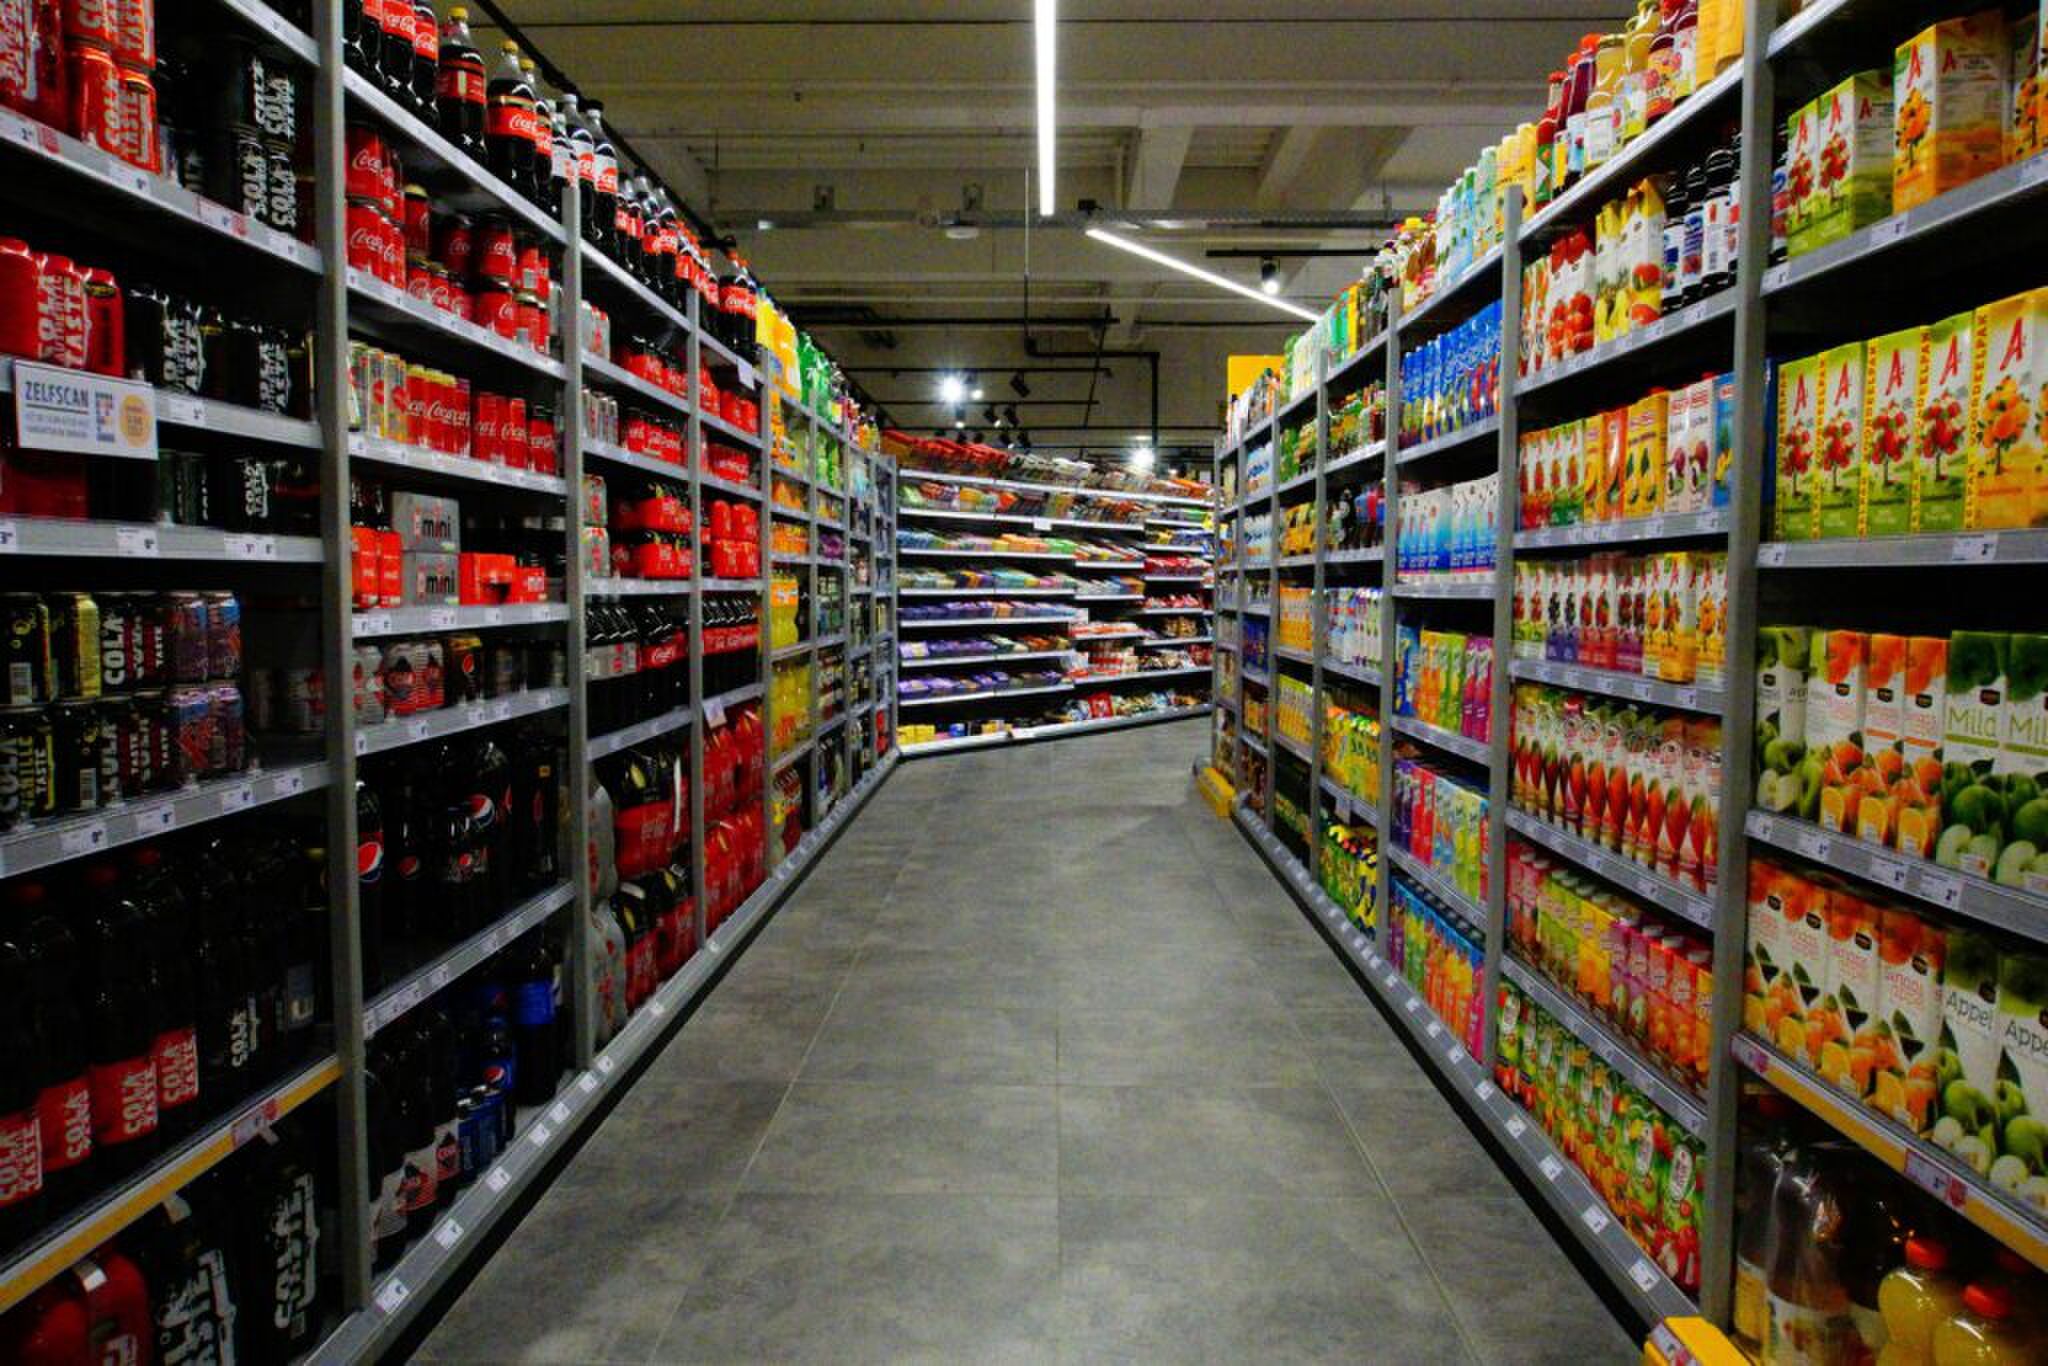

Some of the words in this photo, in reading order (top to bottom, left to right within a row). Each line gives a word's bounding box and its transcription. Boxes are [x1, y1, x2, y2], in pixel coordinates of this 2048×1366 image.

[24, 381, 89, 408] ZELFSCAN
[103, 613, 126, 686] COLA
[1948, 706, 1998, 737] Mild
[1946, 991, 1994, 1031] Appel
